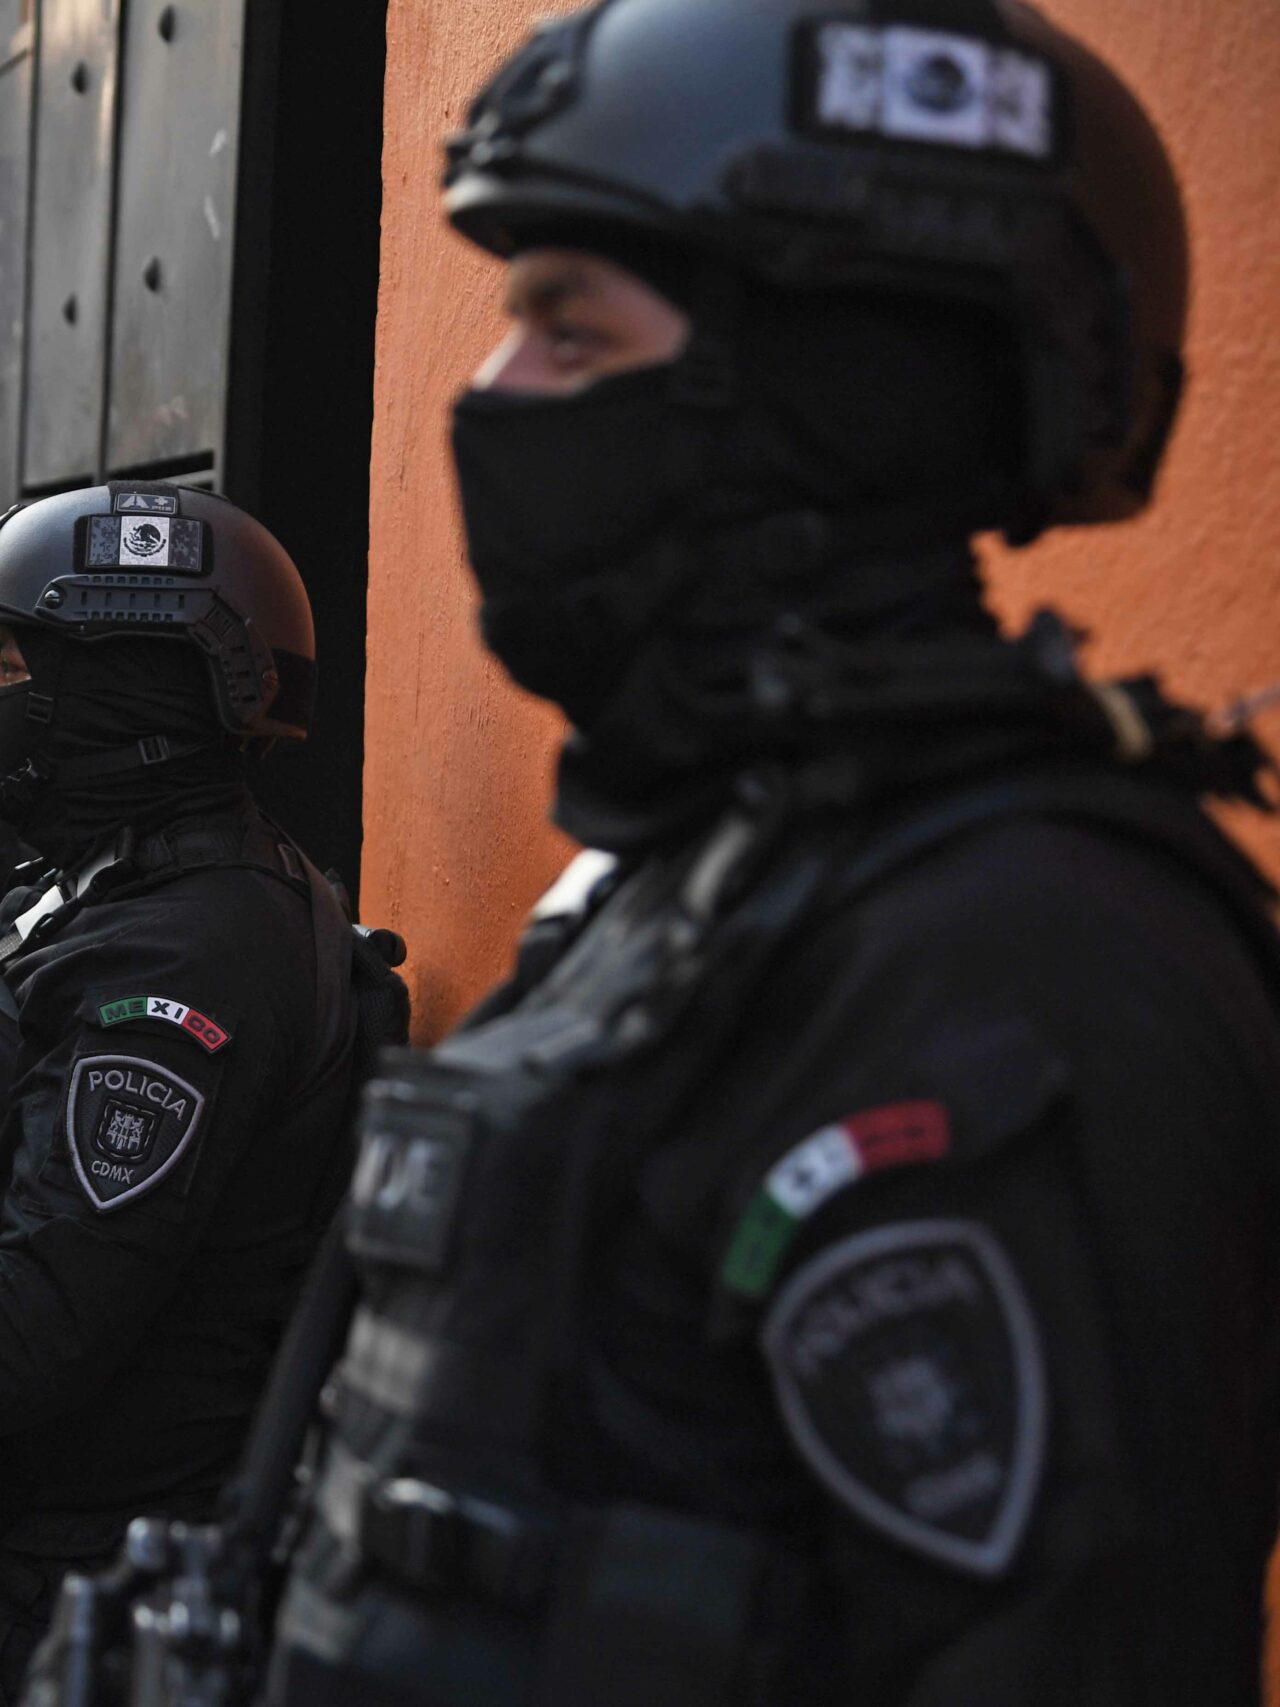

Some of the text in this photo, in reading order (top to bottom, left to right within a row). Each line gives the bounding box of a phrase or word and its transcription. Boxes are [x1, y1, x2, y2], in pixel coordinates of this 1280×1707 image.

[106, 1000, 221, 1045] MEXICO
[88, 1069, 187, 1121] POLICIA
[91, 1160, 134, 1184] CDMX
